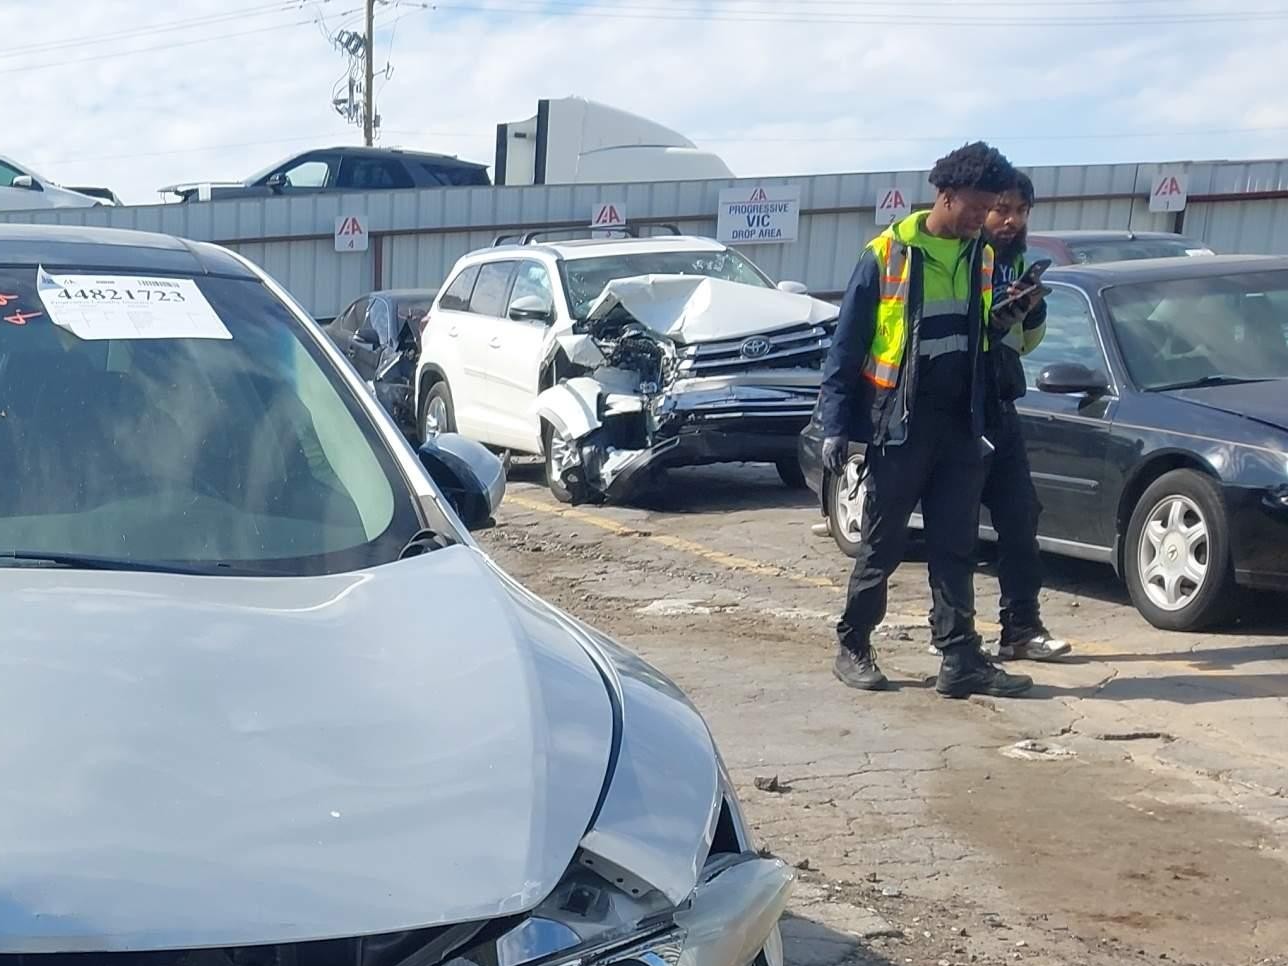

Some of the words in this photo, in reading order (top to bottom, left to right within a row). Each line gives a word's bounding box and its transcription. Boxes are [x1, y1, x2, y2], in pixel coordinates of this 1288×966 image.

[728, 203, 790, 215] PROGRESSIVE
[746, 214, 771, 228] VIC
[732, 229, 756, 240] DROP
[758, 228, 782, 239] AREA
[347, 239, 355, 249] 4
[57, 287, 186, 303] 44821723
